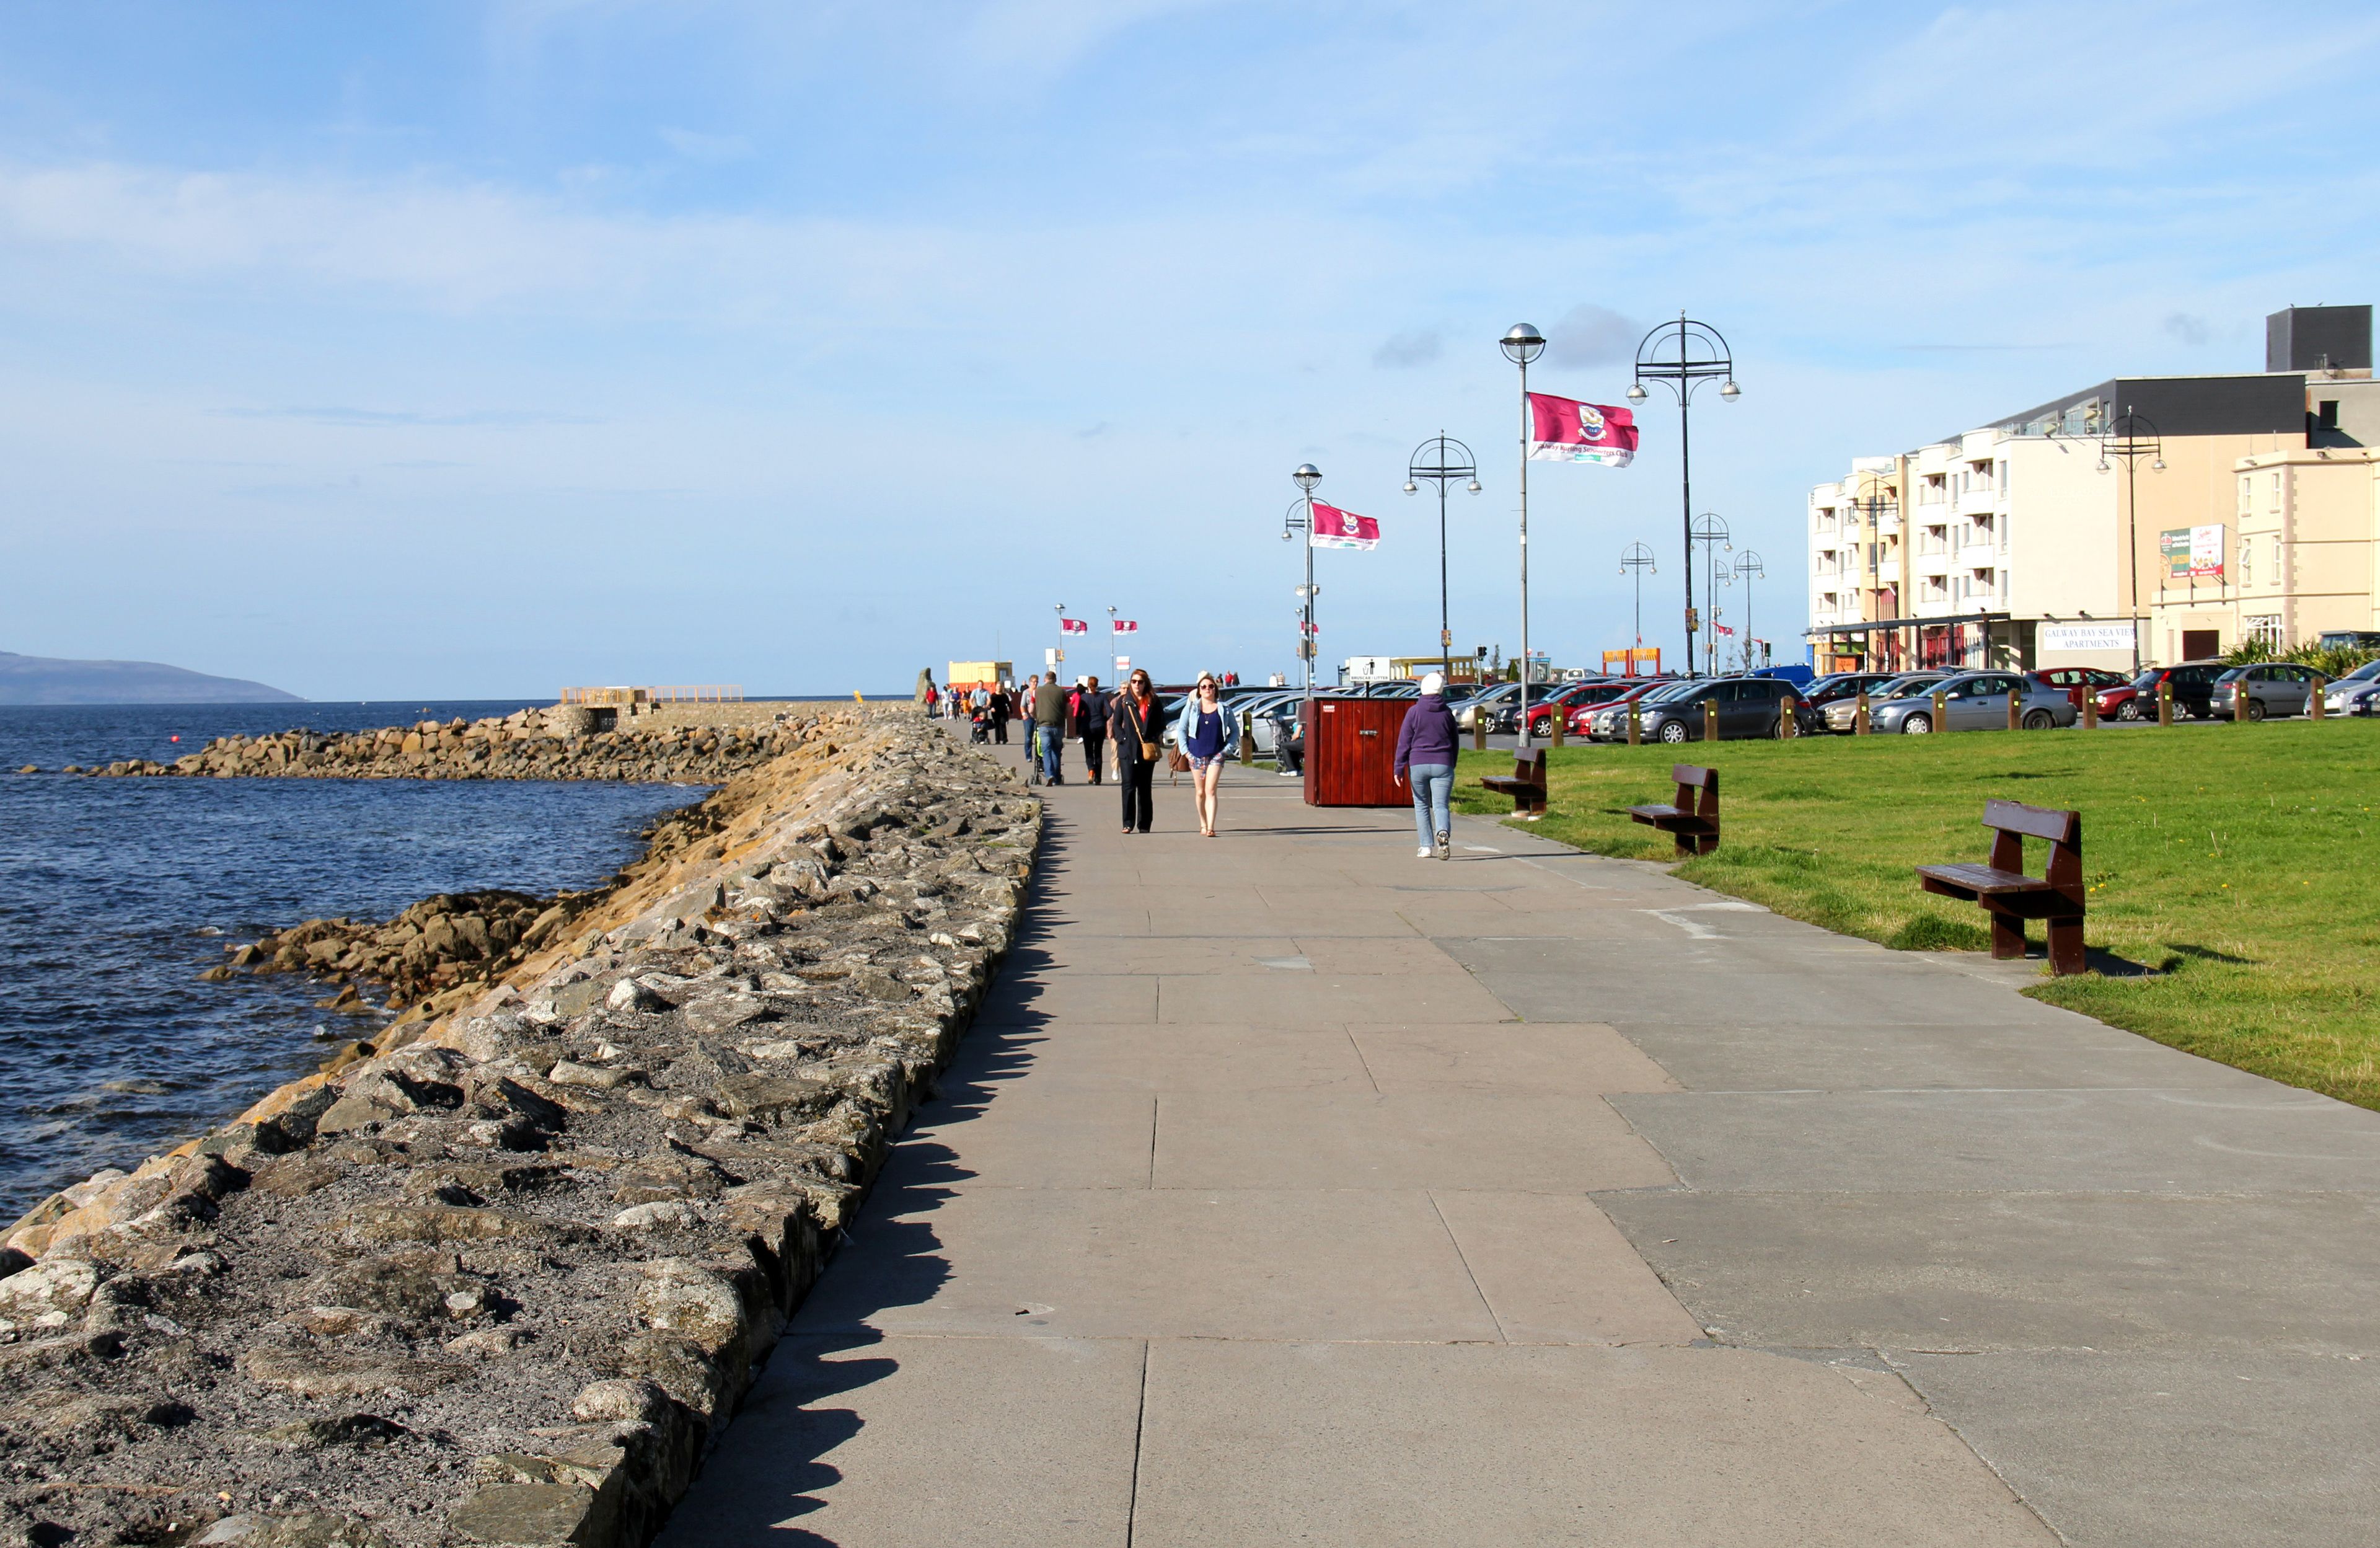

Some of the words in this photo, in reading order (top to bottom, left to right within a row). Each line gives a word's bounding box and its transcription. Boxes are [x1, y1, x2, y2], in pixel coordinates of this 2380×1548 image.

[1560, 444, 1581, 453] Hurling
[2045, 629, 2079, 637] GALWAY
[2081, 629, 2097, 637] BAY
[2098, 628, 2113, 636] SEA
[2064, 639, 2120, 648] APARTMENTS
